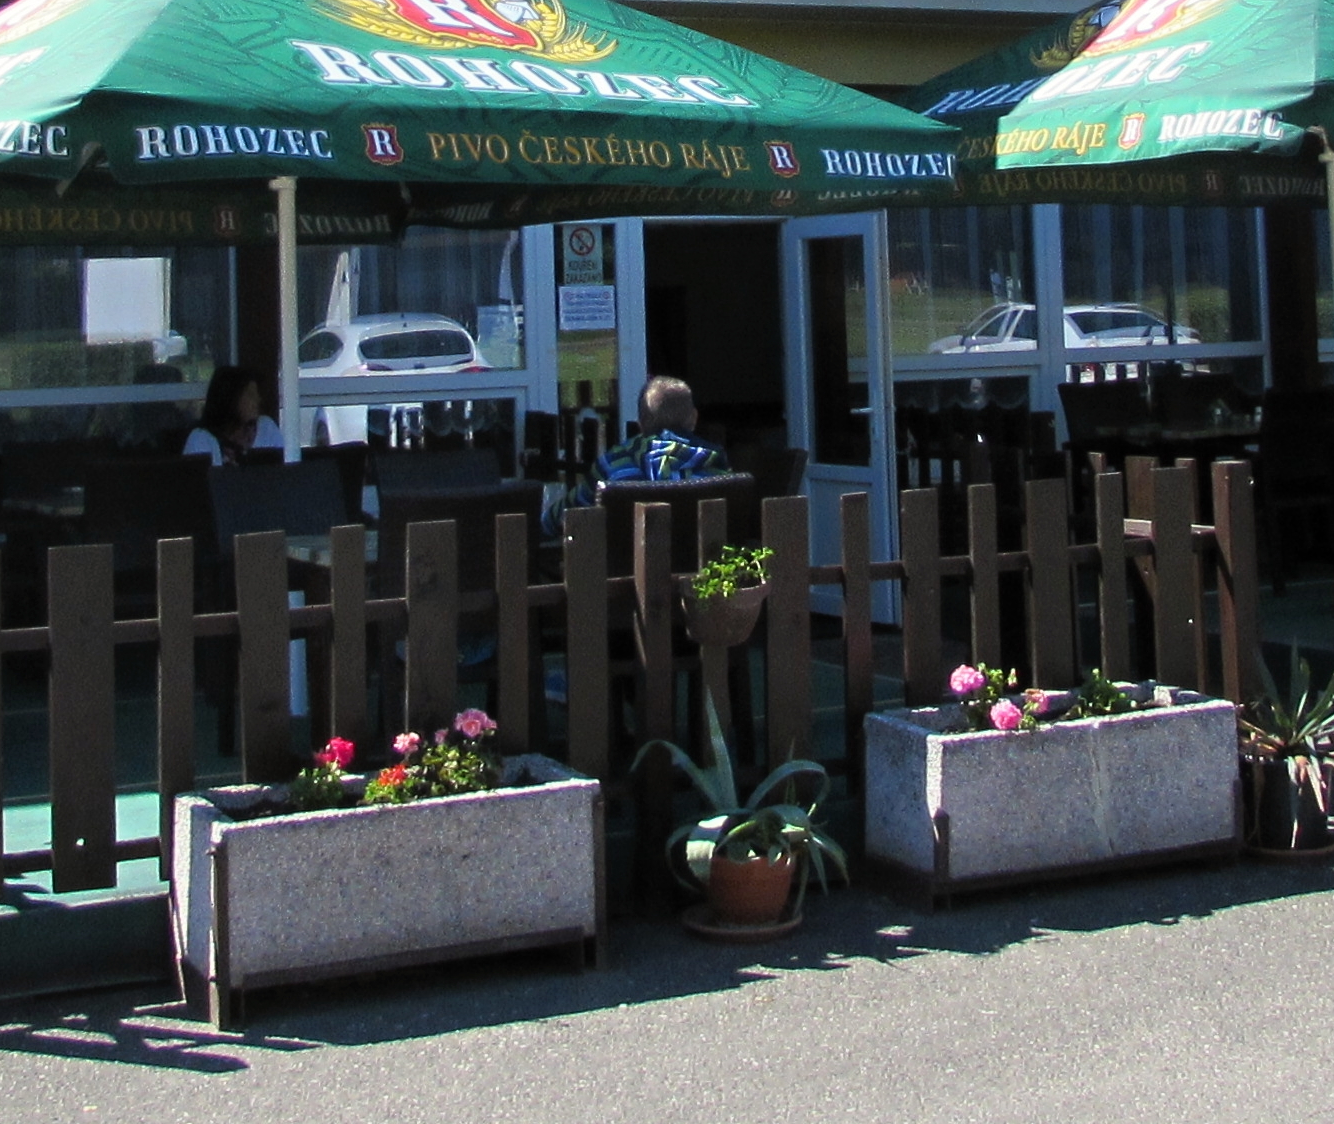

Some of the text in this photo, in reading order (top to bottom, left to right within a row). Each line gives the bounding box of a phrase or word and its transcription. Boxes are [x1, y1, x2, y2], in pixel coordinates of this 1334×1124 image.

[289, 38, 759, 107] ROHOZEC
[136, 124, 334, 161] ROHOZEC
[371, 128, 395, 156] R
[427, 132, 510, 166] PIVO
[518, 130, 672, 171] ČESKÉHO
[683, 136, 751, 176] RÁJE
[1054, 121, 1106, 154] RÁJE
[1158, 109, 1285, 142] ROHOZEC
